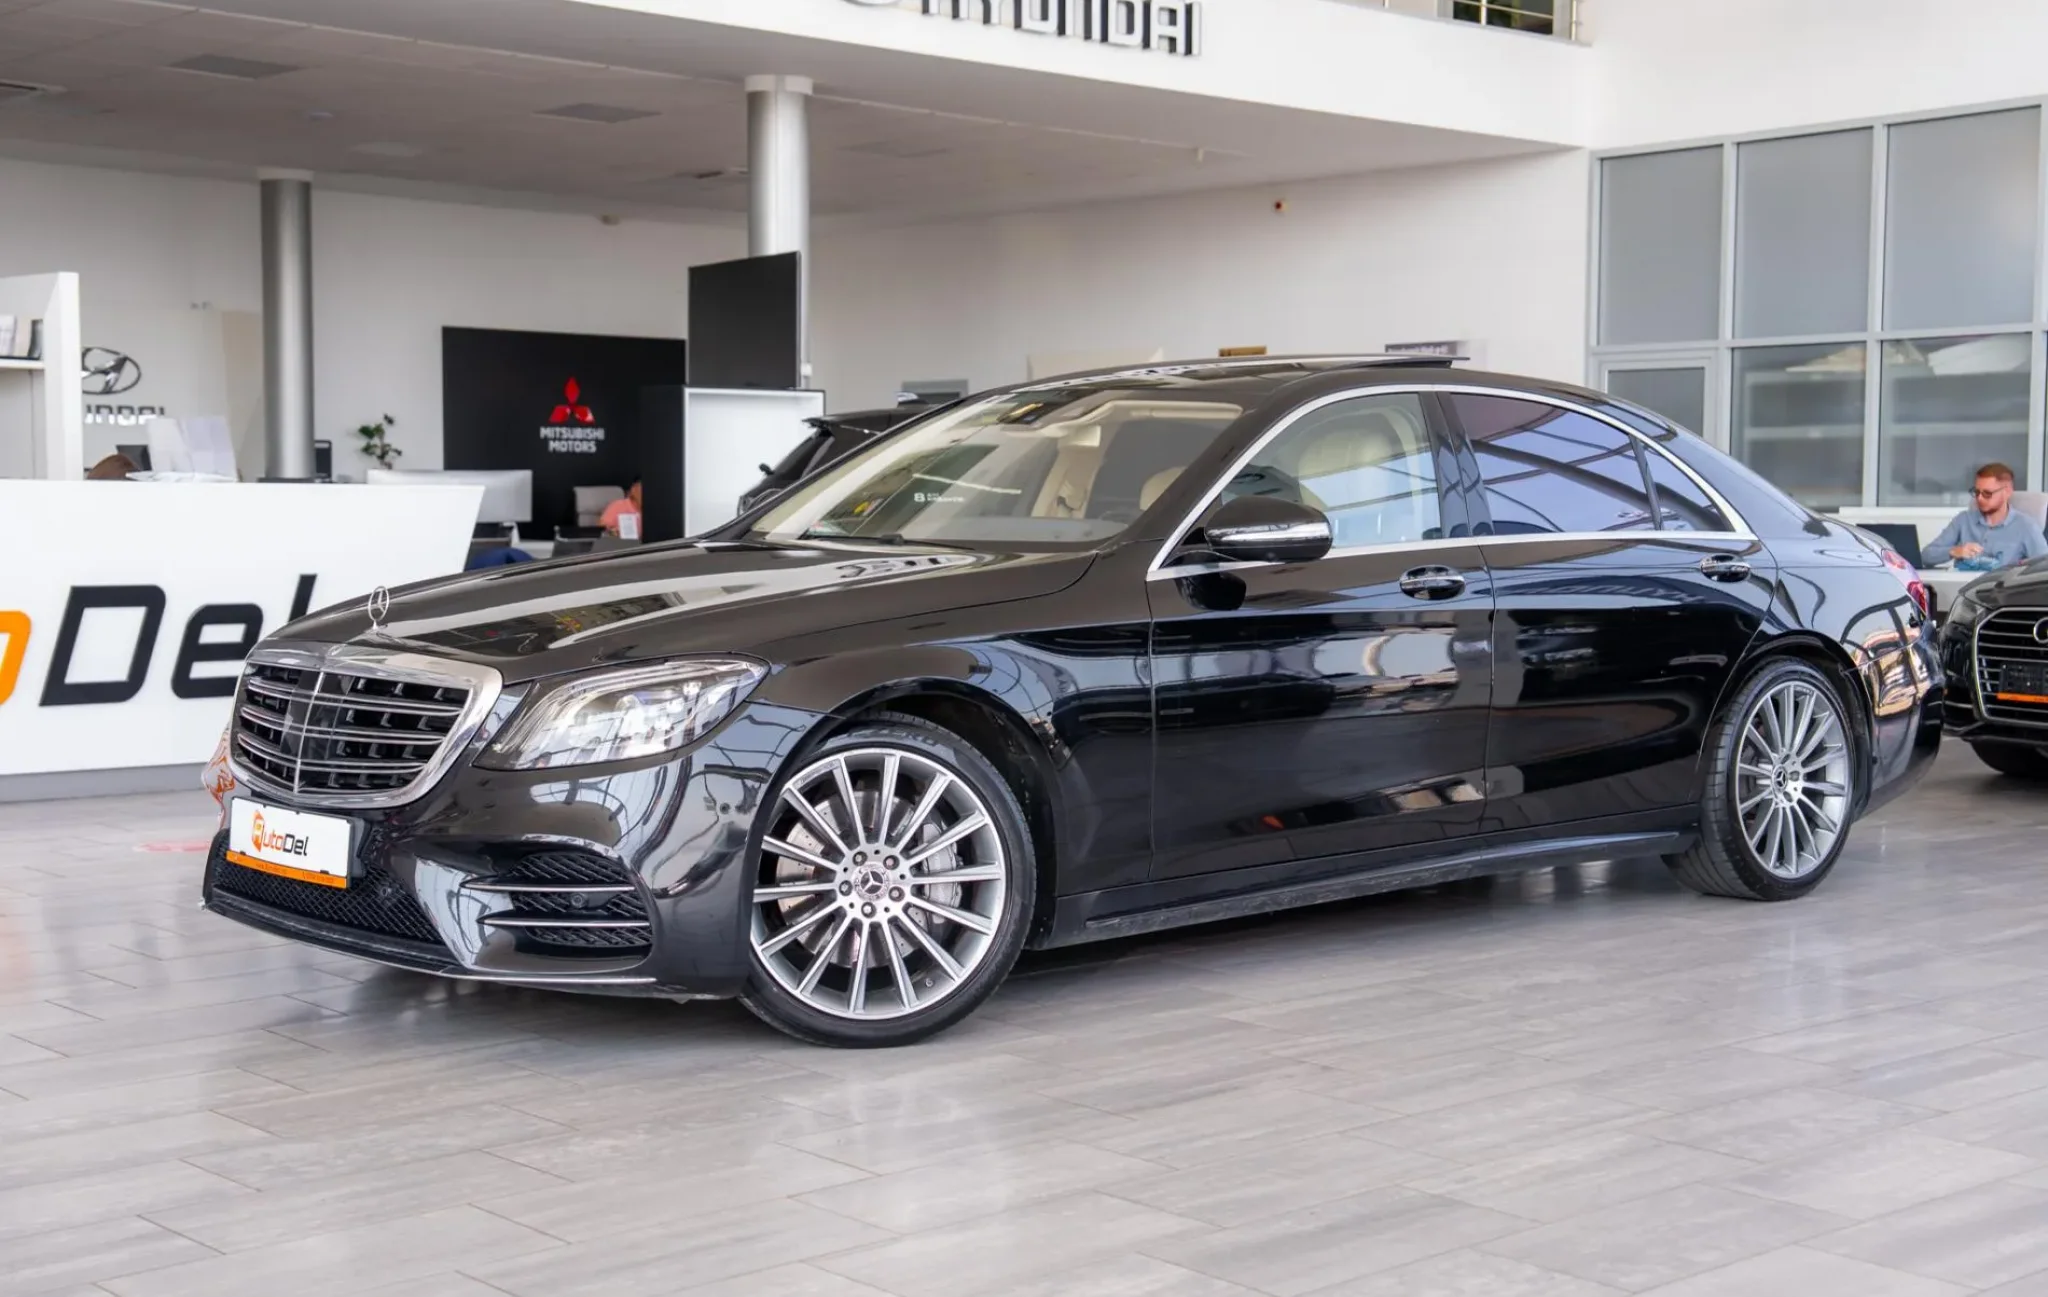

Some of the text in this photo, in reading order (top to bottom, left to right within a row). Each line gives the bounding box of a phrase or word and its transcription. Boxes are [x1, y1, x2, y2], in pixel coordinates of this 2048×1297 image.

[920, 0, 1202, 56] UNDAI
[540, 426, 605, 440] MITSUBISHI
[548, 440, 597, 452] MOTORS
